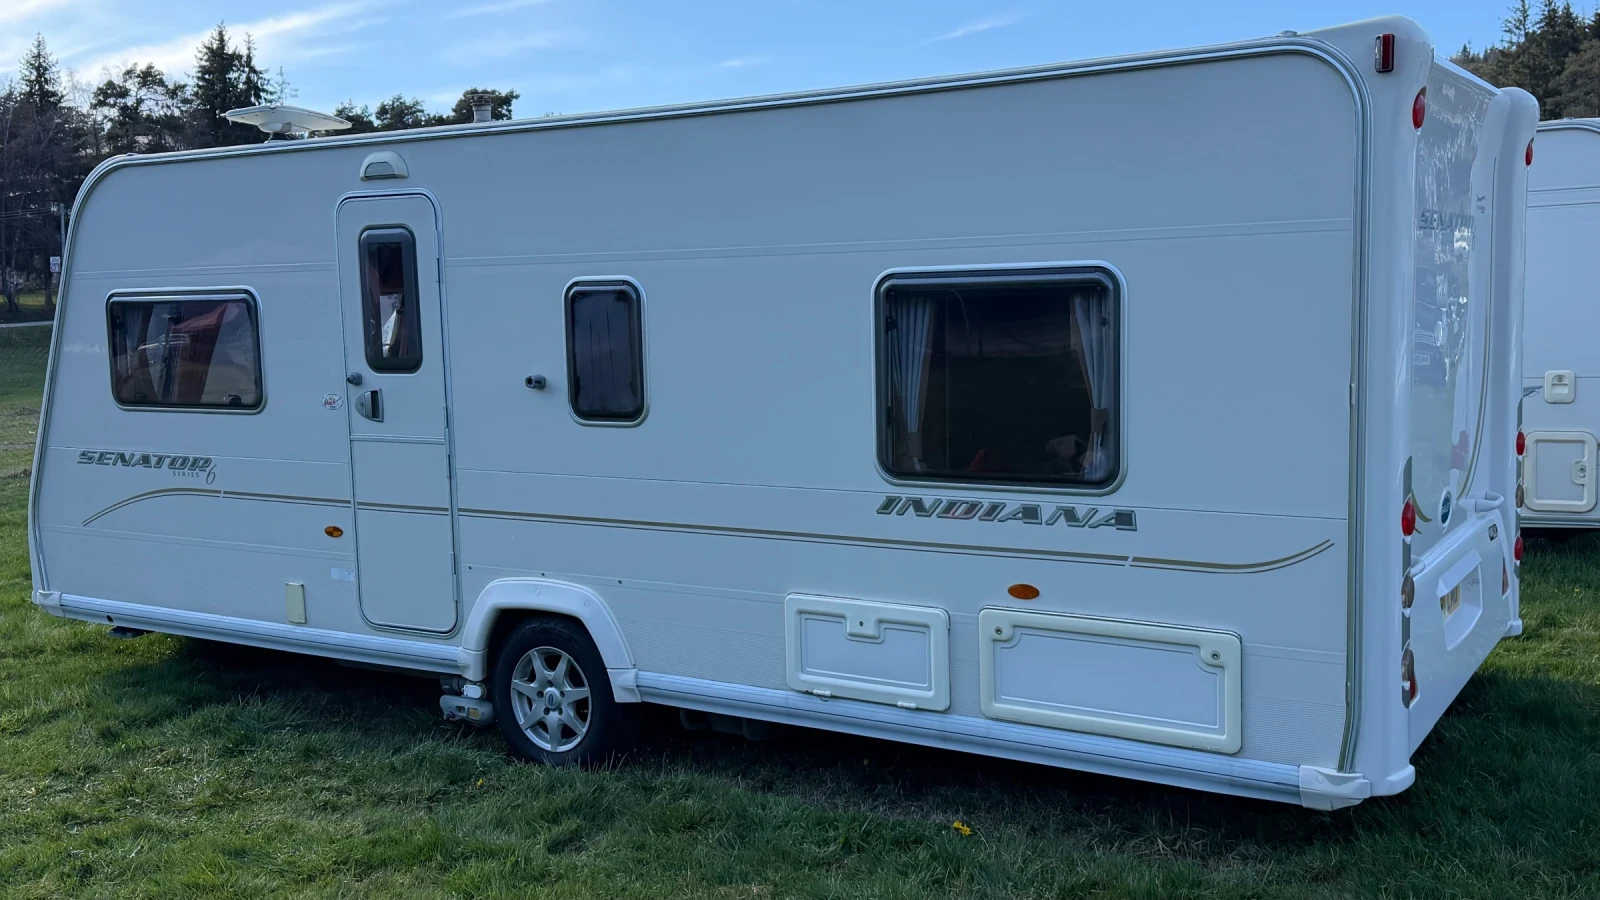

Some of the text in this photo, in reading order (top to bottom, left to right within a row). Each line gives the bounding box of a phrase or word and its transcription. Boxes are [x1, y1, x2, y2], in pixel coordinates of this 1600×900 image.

[77, 450, 213, 472] SENATOR
[172, 464, 217, 485] SERIES 6
[876, 495, 1138, 531] INDIANA
